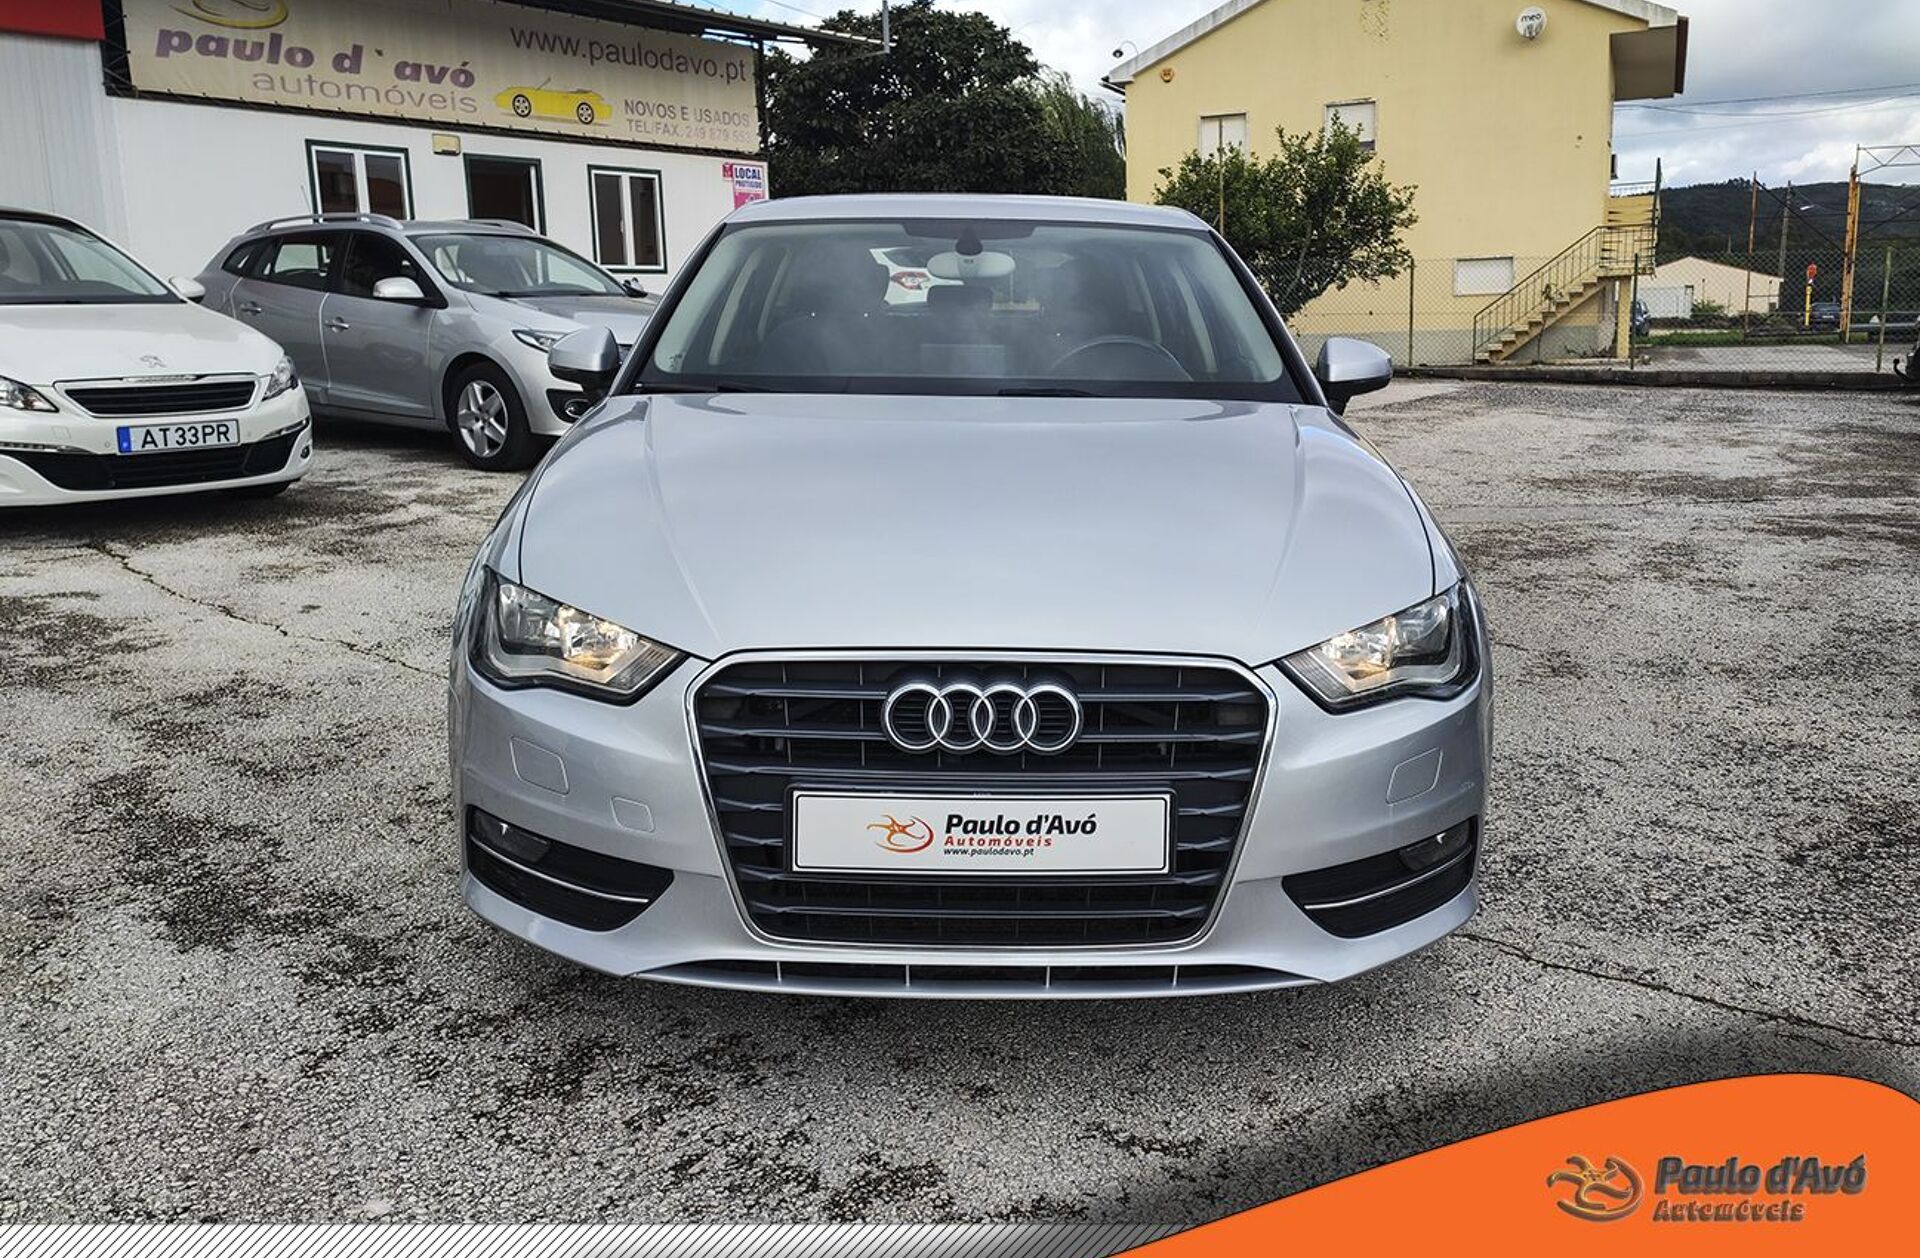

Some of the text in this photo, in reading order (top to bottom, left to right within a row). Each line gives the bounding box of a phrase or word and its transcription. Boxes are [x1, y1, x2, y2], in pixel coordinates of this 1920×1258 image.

[155, 29, 315, 69] paulo
[510, 27, 747, 84] www.paulodavo.pt
[253, 72, 477, 114] automóveis
[624, 99, 750, 127] NOVOS E USADOS
[735, 167, 762, 180] LOCAL
[945, 814, 1020, 835] Paulo
[944, 836, 1052, 847] Automóveis
[944, 848, 1035, 858] www.paulodavo.pt
